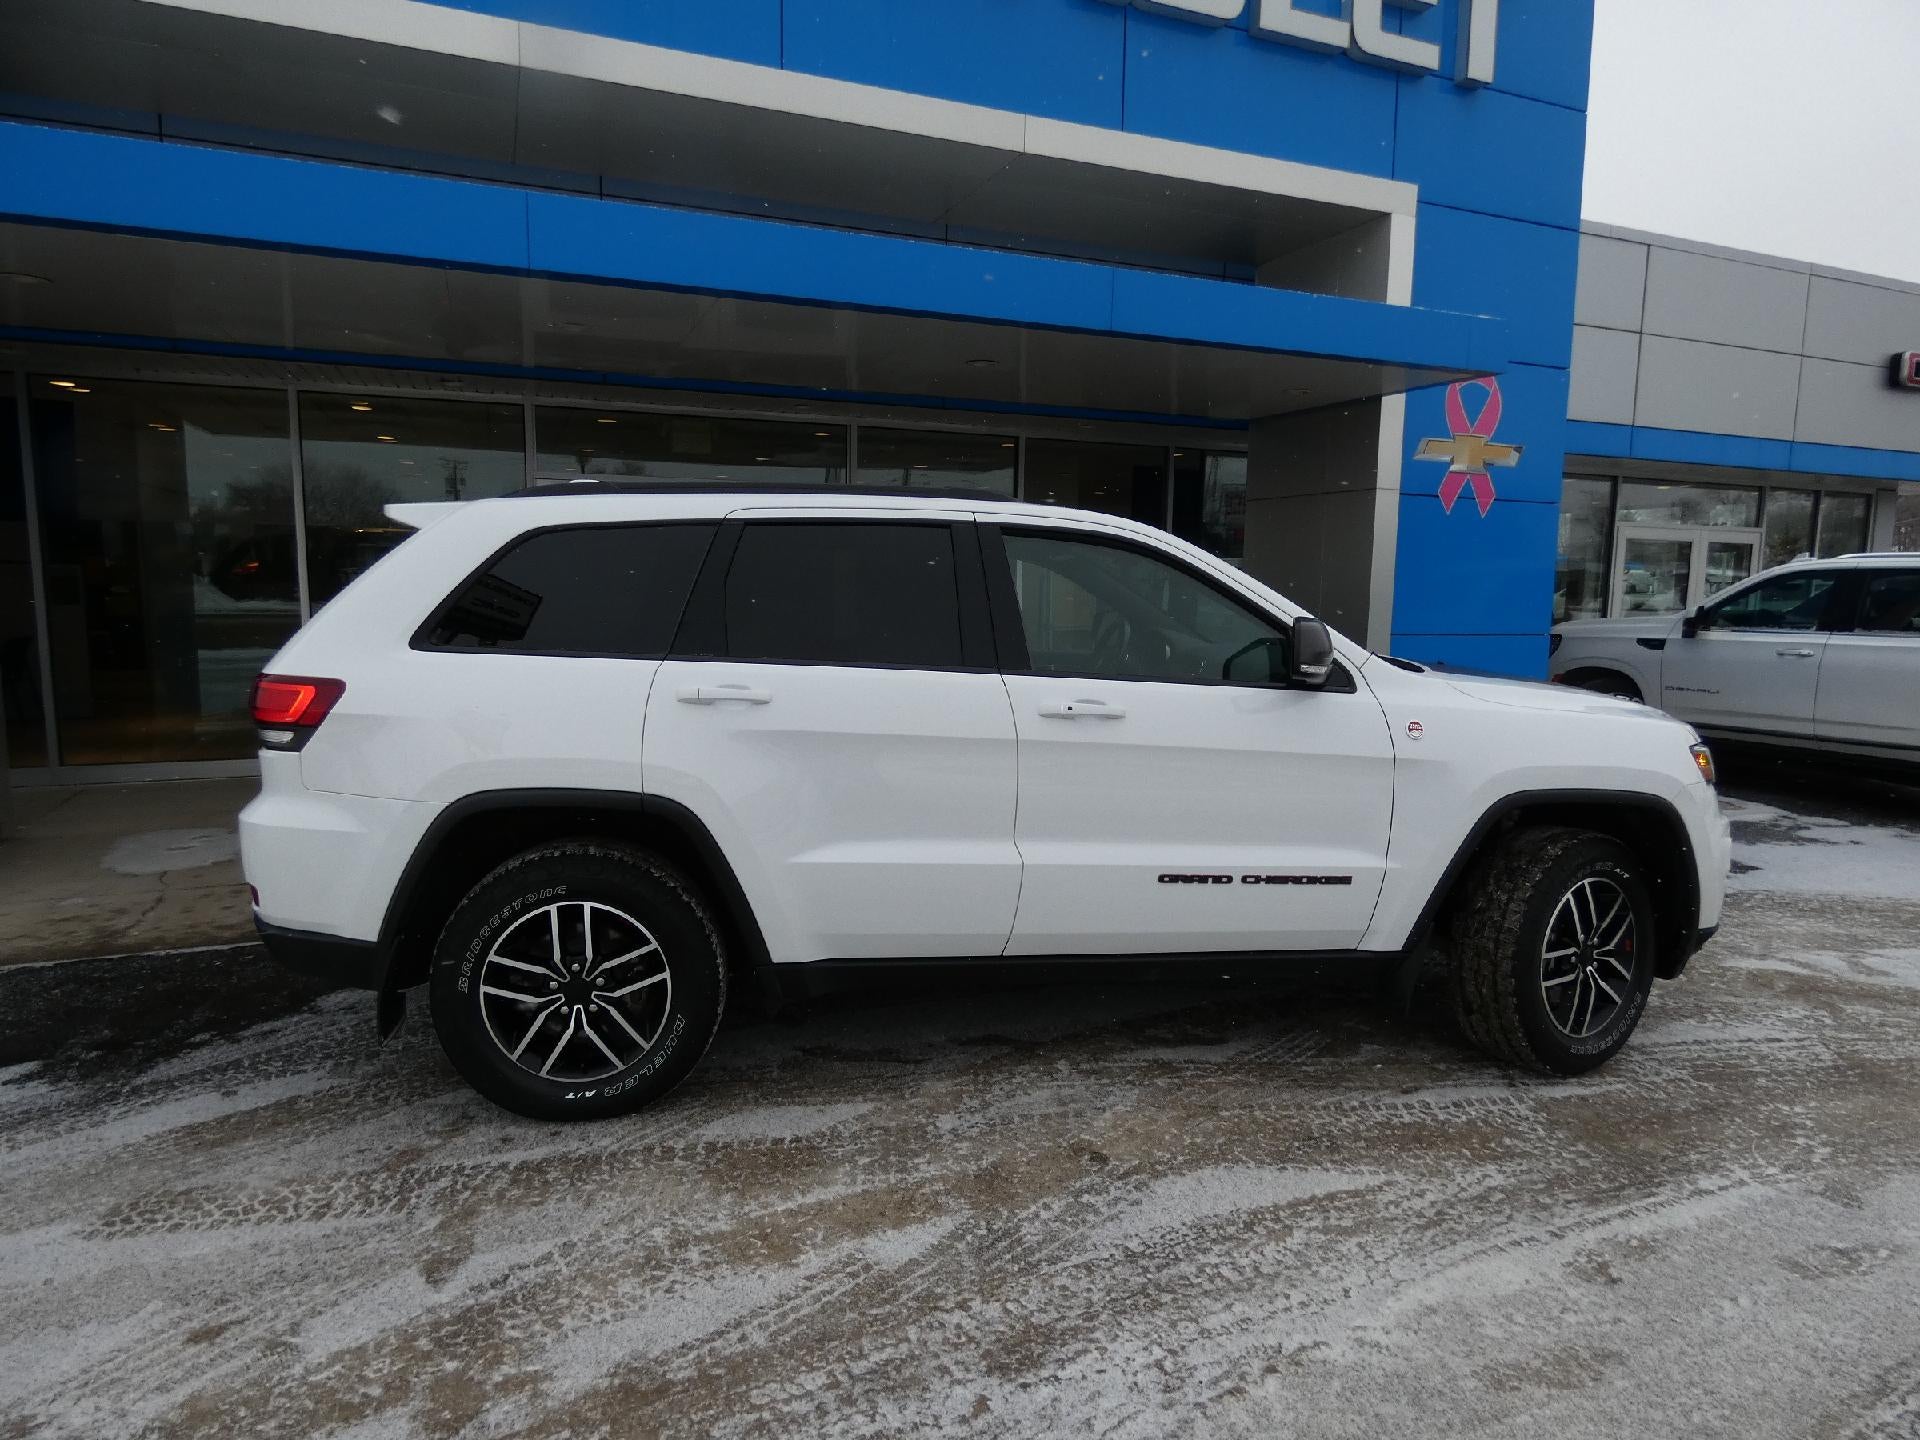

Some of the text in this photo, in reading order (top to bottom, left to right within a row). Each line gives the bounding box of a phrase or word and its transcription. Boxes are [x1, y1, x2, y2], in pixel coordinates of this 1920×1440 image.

[1157, 873, 1353, 886] GRAND CHEROKEE
[456, 885, 568, 995] BRIDGESTONE
[564, 1013, 686, 1100] DUELER A/T
